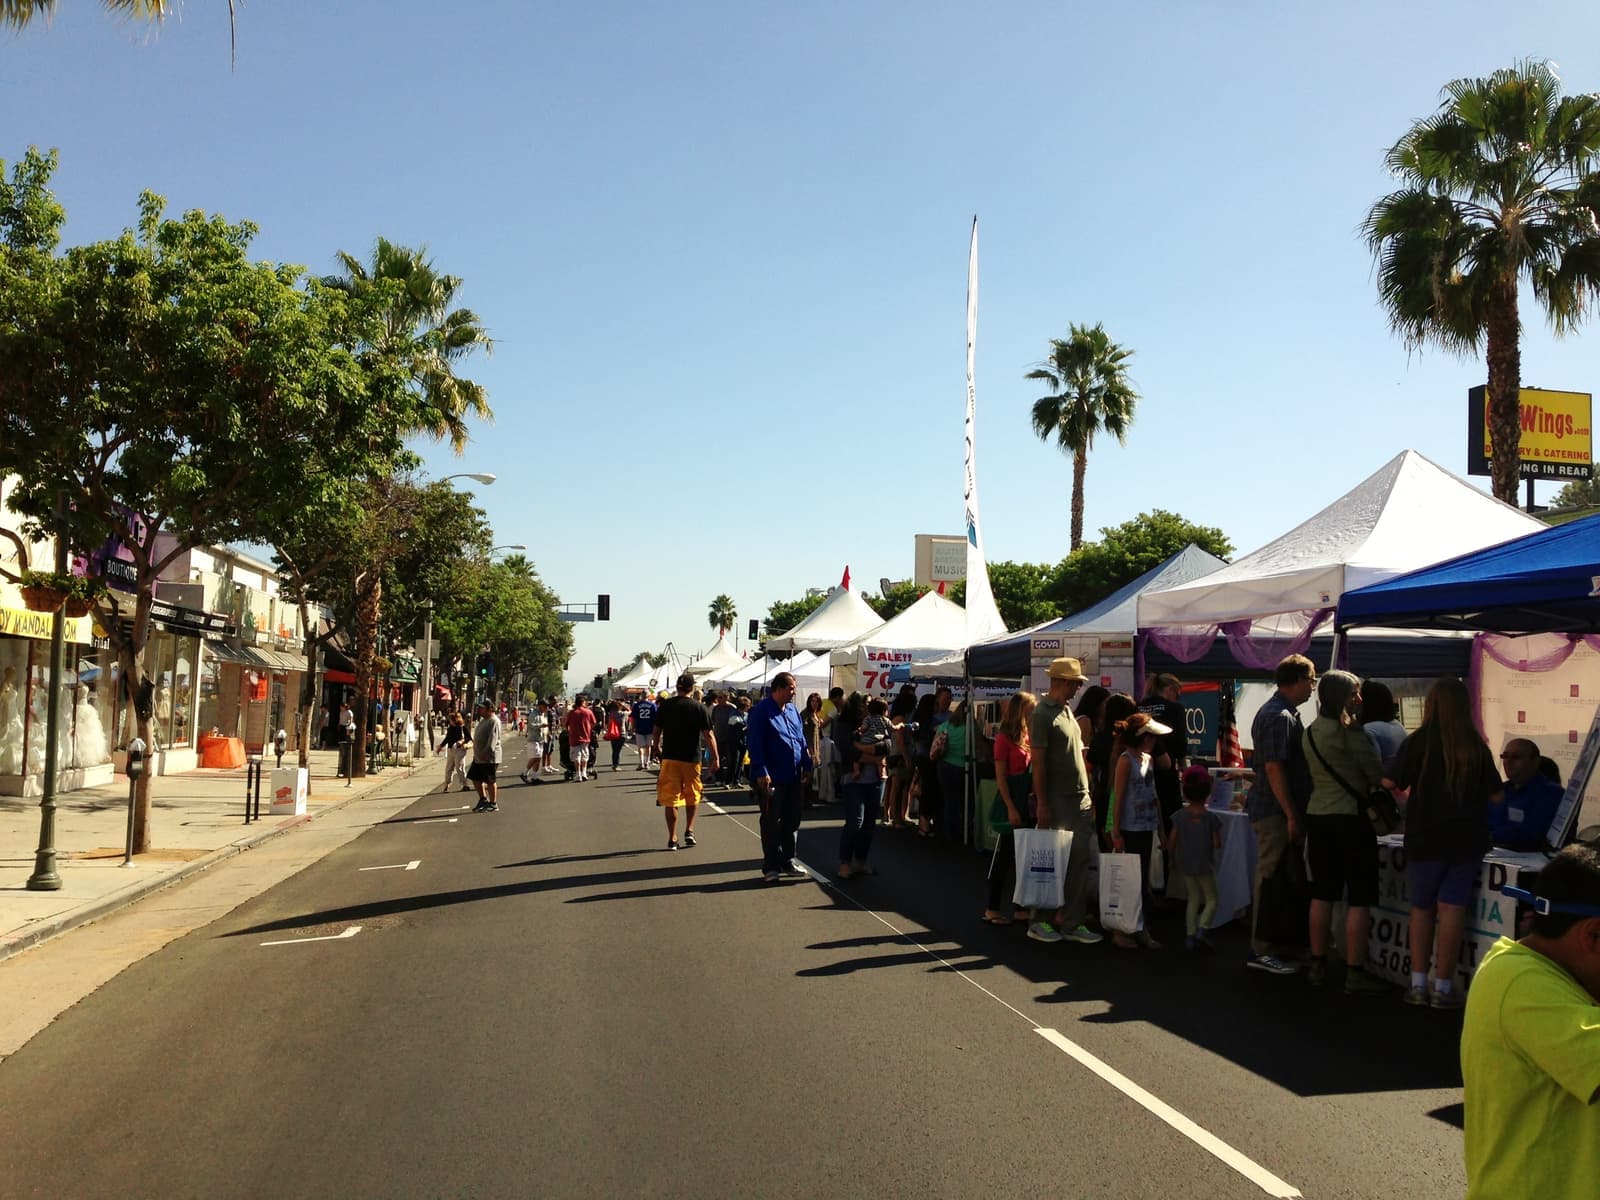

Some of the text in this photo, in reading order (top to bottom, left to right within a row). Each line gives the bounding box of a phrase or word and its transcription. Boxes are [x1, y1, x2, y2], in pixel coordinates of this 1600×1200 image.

[1534, 448, 1541, 456] &
[1543, 449, 1589, 460] CATERING
[1543, 465, 1555, 474] IN
[1559, 467, 1588, 476] REAR
[107, 560, 138, 580] BOUTIQUE
[935, 565, 967, 575] MUSIC
[640, 709, 650, 719] 22
